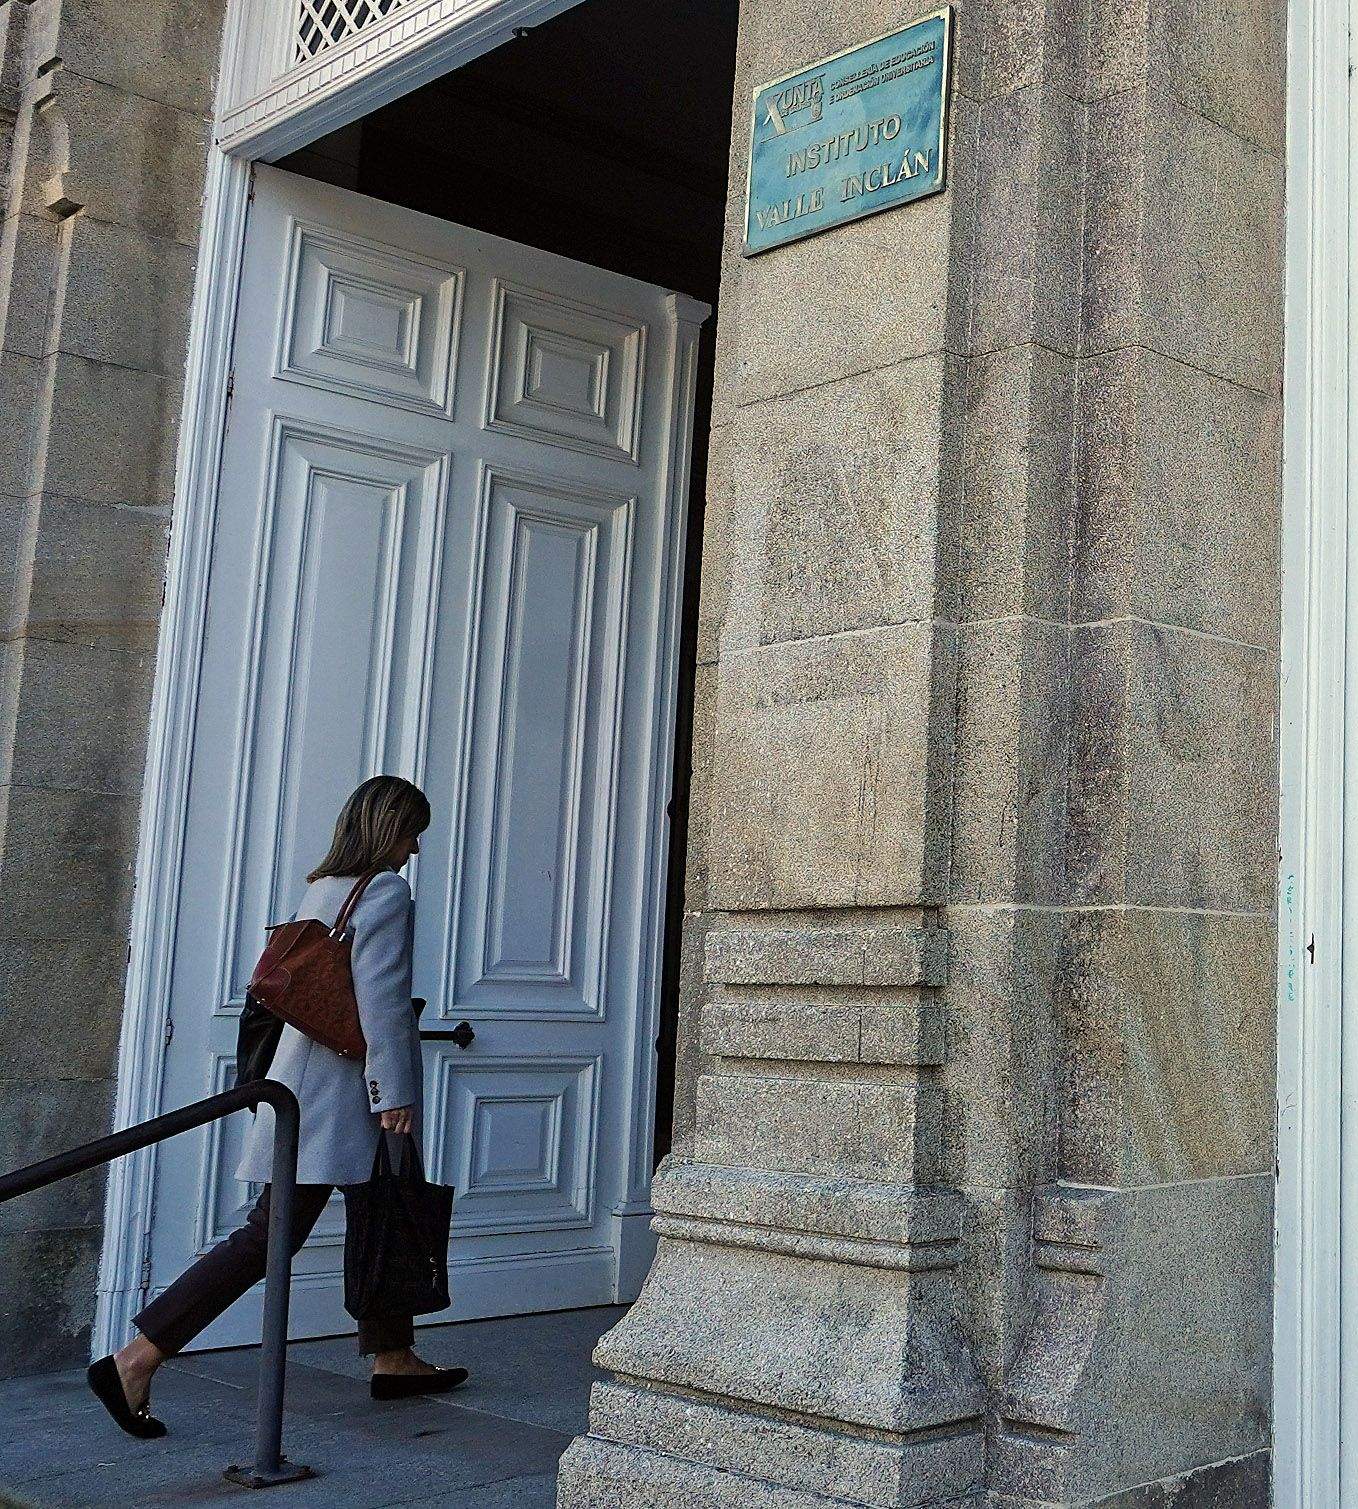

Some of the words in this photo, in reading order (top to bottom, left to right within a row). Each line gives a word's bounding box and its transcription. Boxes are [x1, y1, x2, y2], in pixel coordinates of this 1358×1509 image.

[763, 73, 826, 135] XUNTA
[786, 113, 902, 178] INSTITUTO
[756, 186, 825, 231] VALLE
[840, 149, 932, 202] INCLÁN
